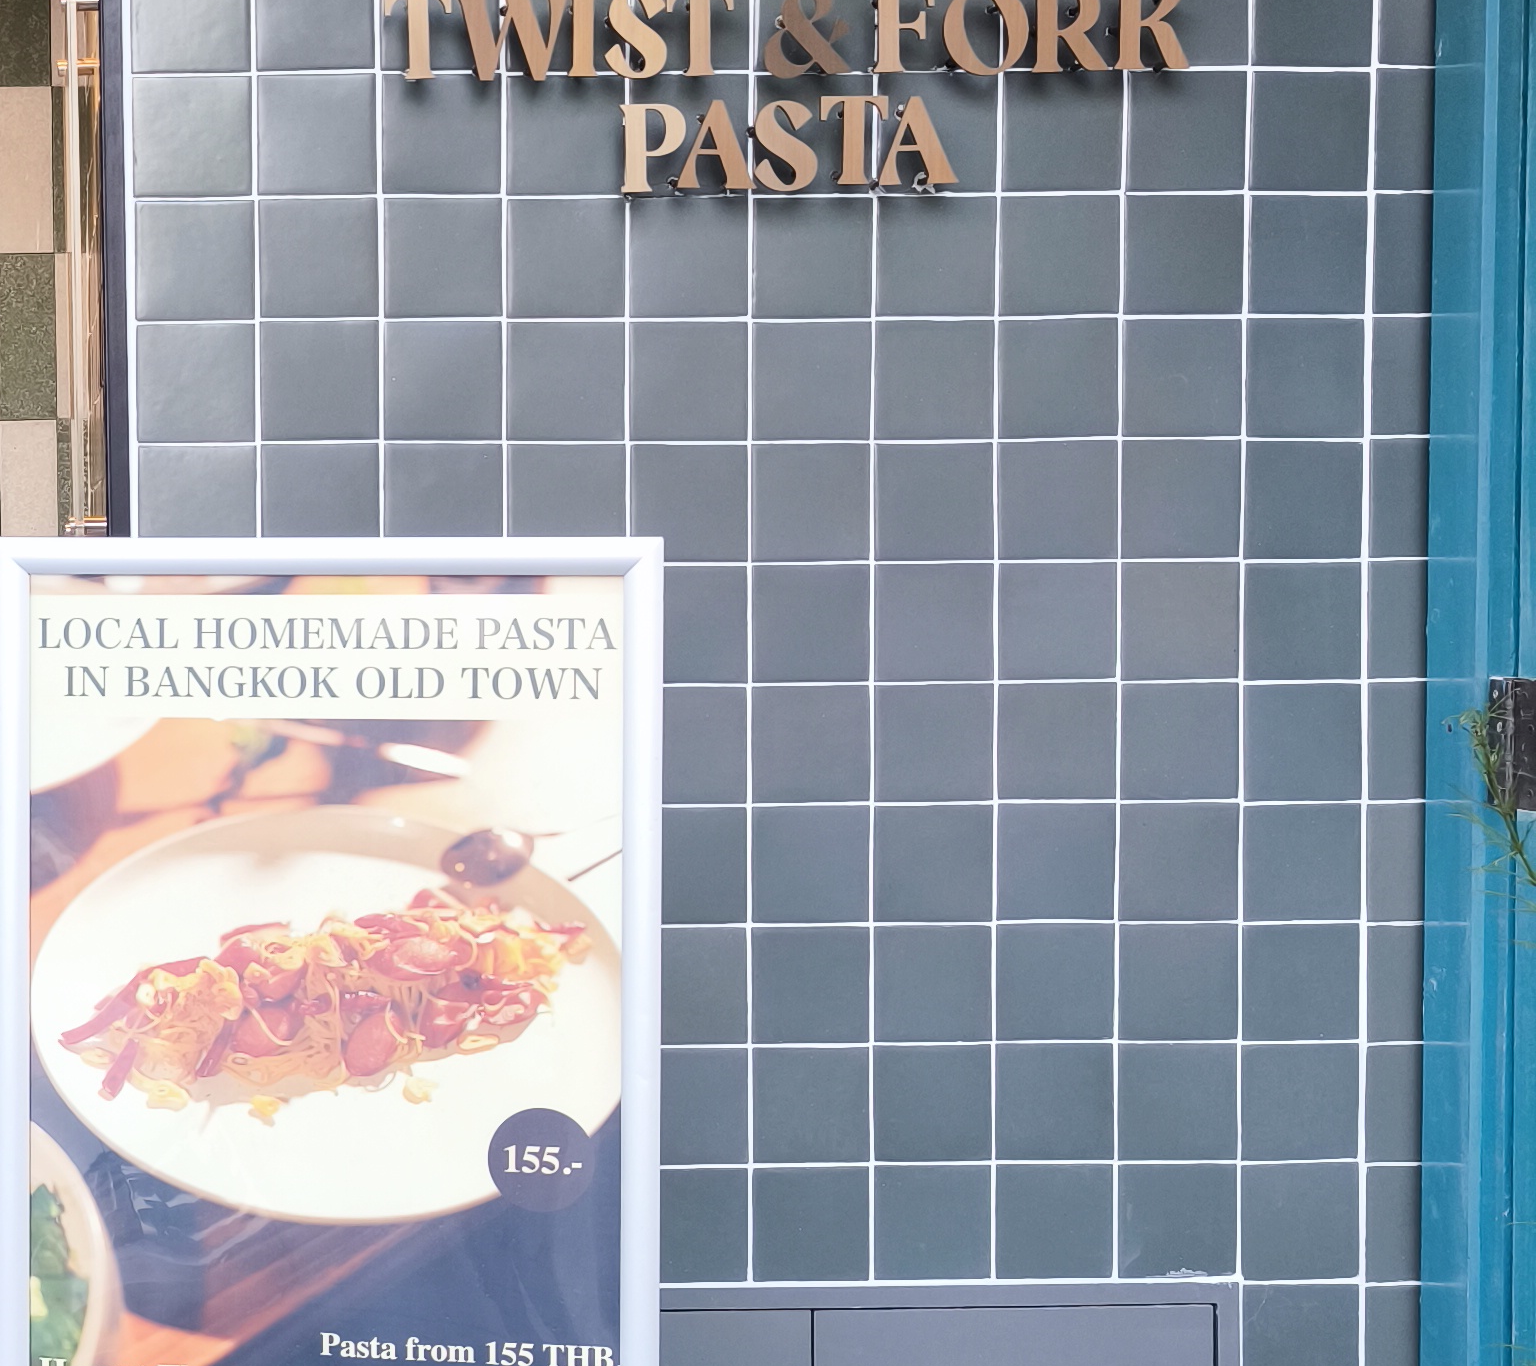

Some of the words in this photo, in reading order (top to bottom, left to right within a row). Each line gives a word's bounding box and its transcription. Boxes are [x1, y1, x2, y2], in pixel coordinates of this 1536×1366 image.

[619, 96, 960, 193] PASTA
[38, 617, 179, 650] LOCAL
[193, 617, 459, 650] HOMEMADE
[474, 617, 618, 651] PASTA
[64, 665, 110, 697] IN
[124, 665, 340, 699] BANGKOK
[355, 666, 445, 699] OLD
[460, 666, 603, 700] TOWN
[503, 1144, 583, 1175] 155.-
[319, 1332, 398, 1361] Pasta
[405, 1337, 476, 1364] from
[484, 1341, 534, 1366] 155
